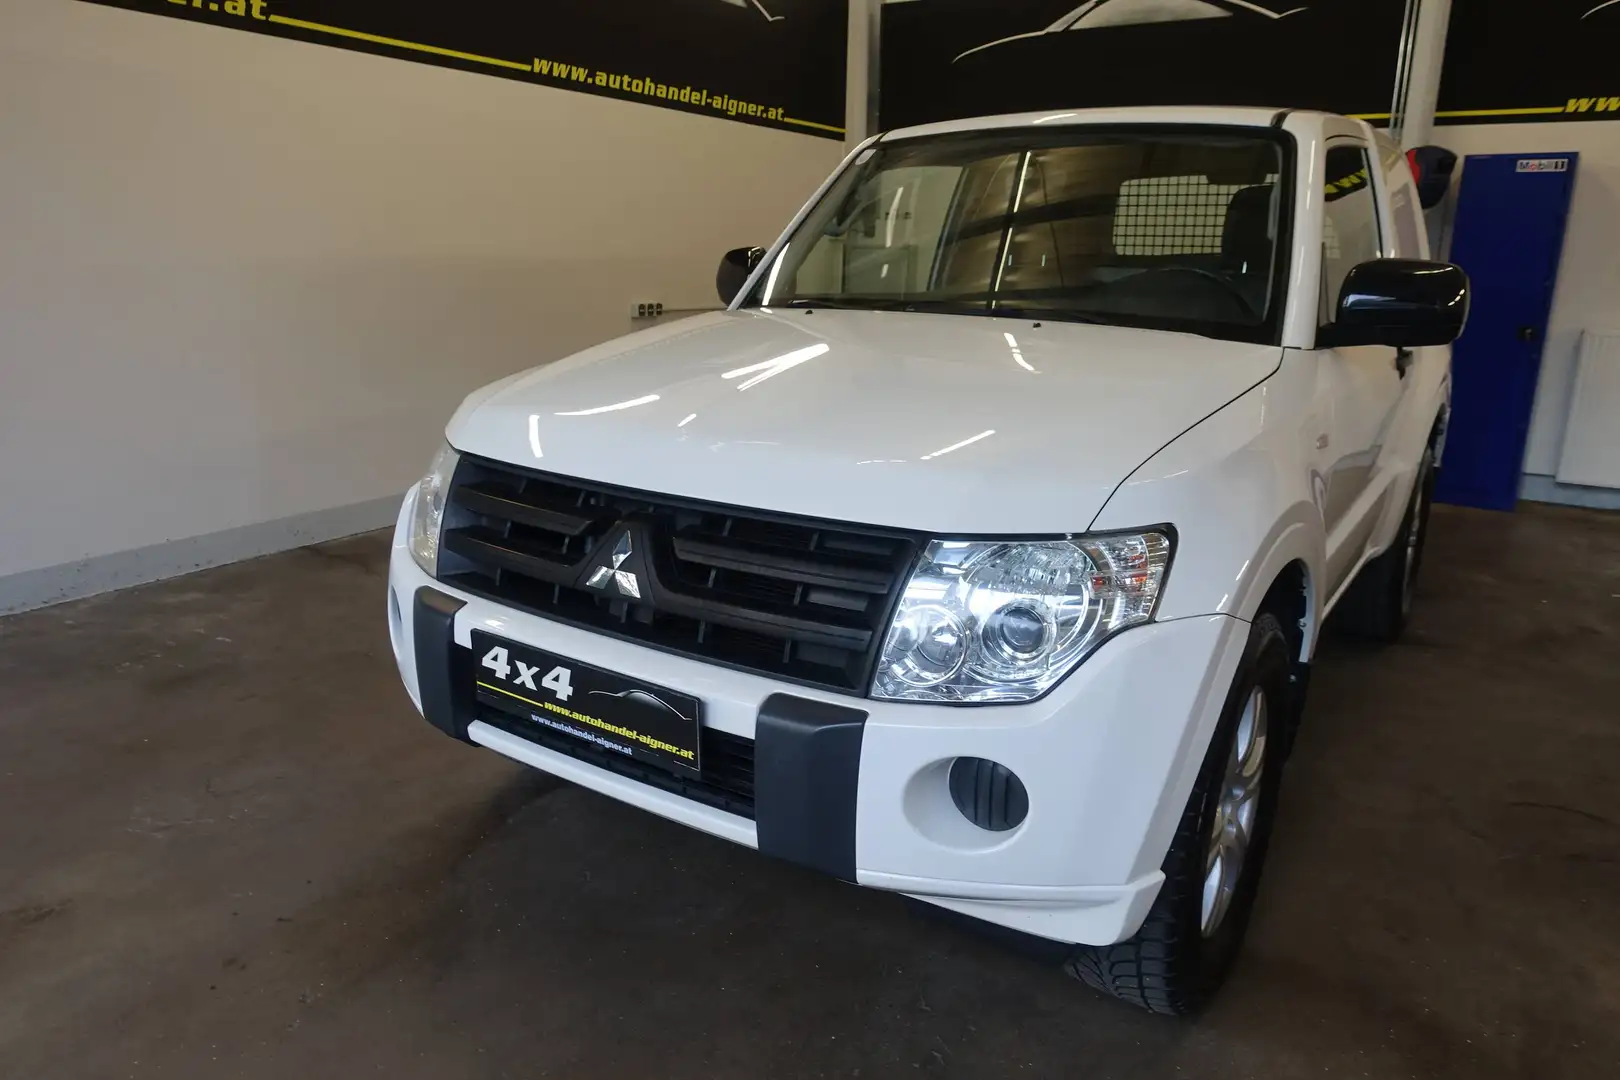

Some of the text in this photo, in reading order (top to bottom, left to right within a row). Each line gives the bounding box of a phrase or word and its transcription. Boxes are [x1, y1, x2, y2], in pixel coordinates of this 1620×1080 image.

[533, 58, 784, 121] www.autohandel-aigner.at
[481, 645, 574, 701] 4x4
[530, 713, 633, 756] www.autohandel-aigner.at
[543, 701, 695, 760] www.autohandel-aigner.at
